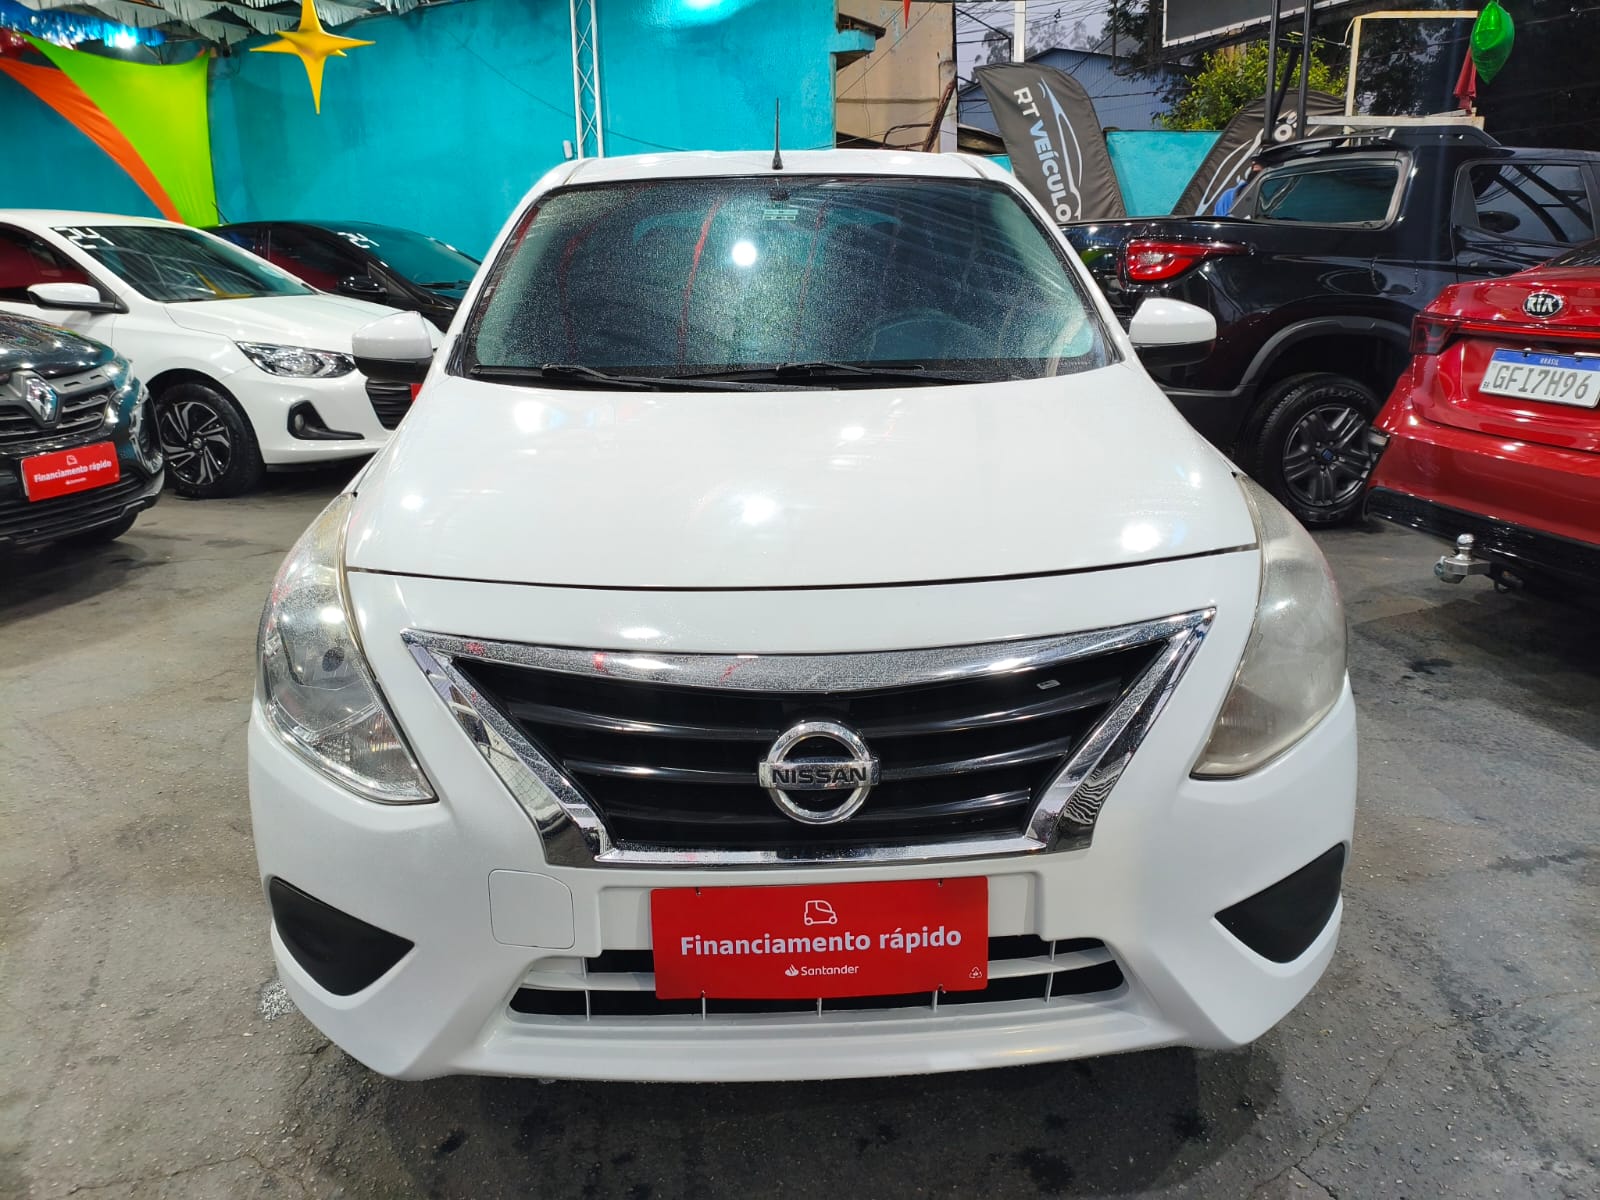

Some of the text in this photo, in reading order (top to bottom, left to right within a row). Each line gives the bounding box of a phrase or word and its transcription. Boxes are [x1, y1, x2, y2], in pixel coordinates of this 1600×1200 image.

[1013, 87, 1040, 117] RT
[53, 227, 115, 249] 24
[1526, 295, 1556, 313] KIA
[1540, 357, 1559, 367] BRASIL
[1492, 365, 1592, 400] GFI7H96
[33, 465, 88, 483] Financiamento
[88, 459, 112, 473] rápido
[772, 767, 867, 784] NISSAN
[680, 925, 962, 956] Financiamento rápido
[800, 964, 859, 977] Santander
